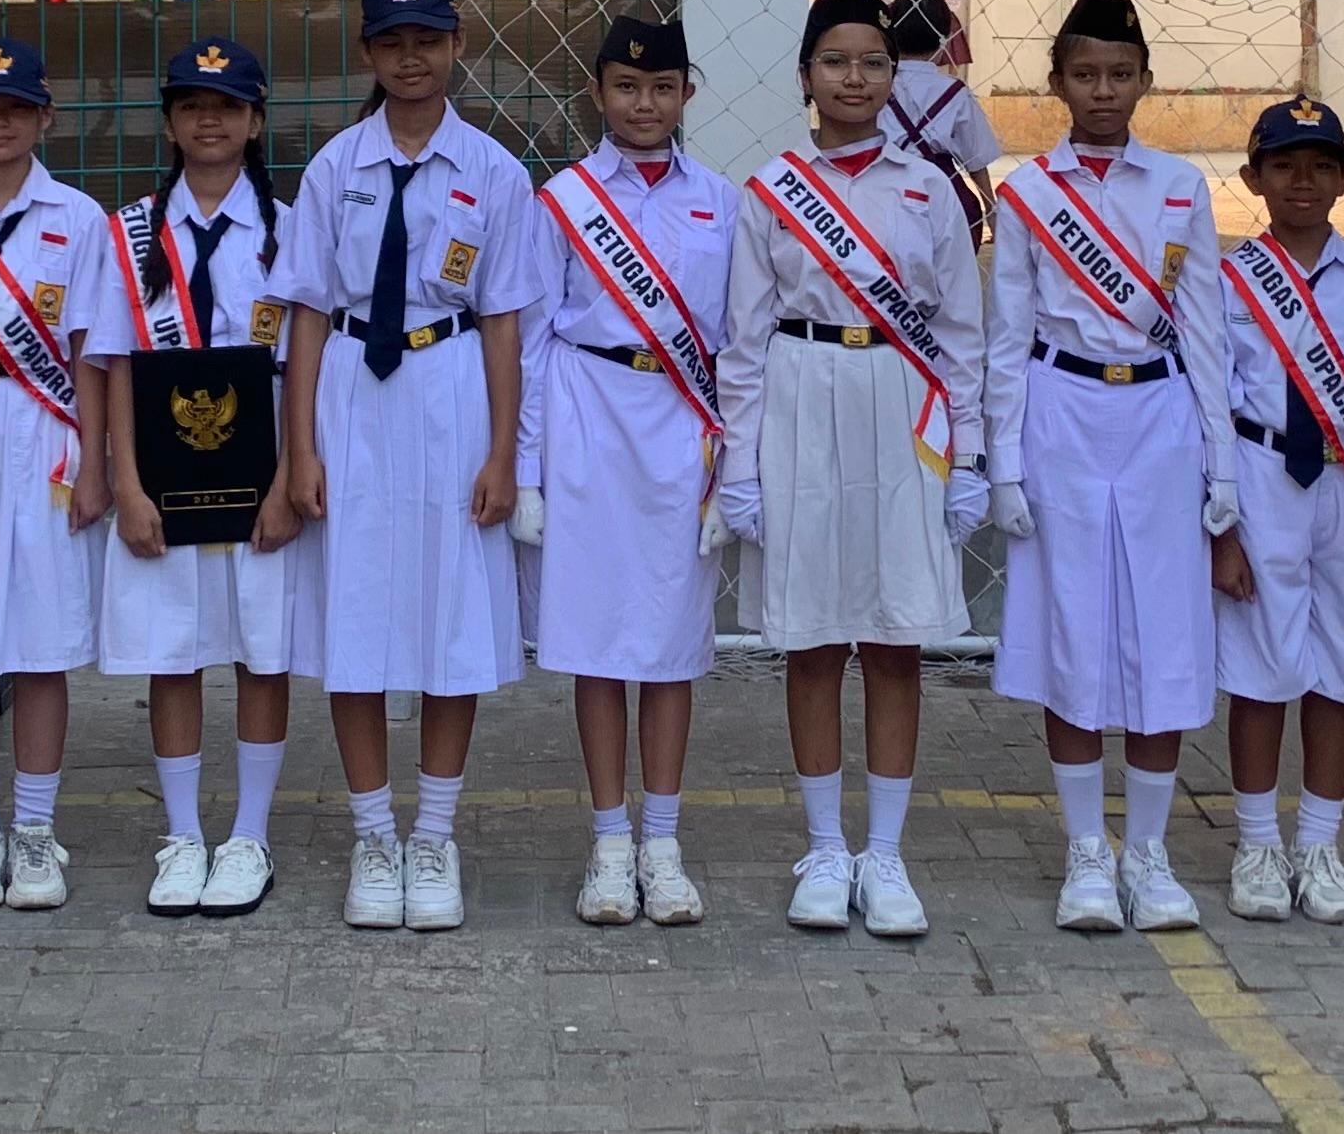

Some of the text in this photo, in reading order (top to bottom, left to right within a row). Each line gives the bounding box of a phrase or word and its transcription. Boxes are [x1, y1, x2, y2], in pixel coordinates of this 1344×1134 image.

[120, 202, 153, 272] ETUG
[774, 170, 942, 362] PETUGAS UPACARA
[1049, 208, 1135, 304] PETUGAS
[1232, 240, 1302, 320] PETUGAS
[584, 214, 720, 414] PETUGAS UPACA
[3, 316, 76, 406] UPACARA
